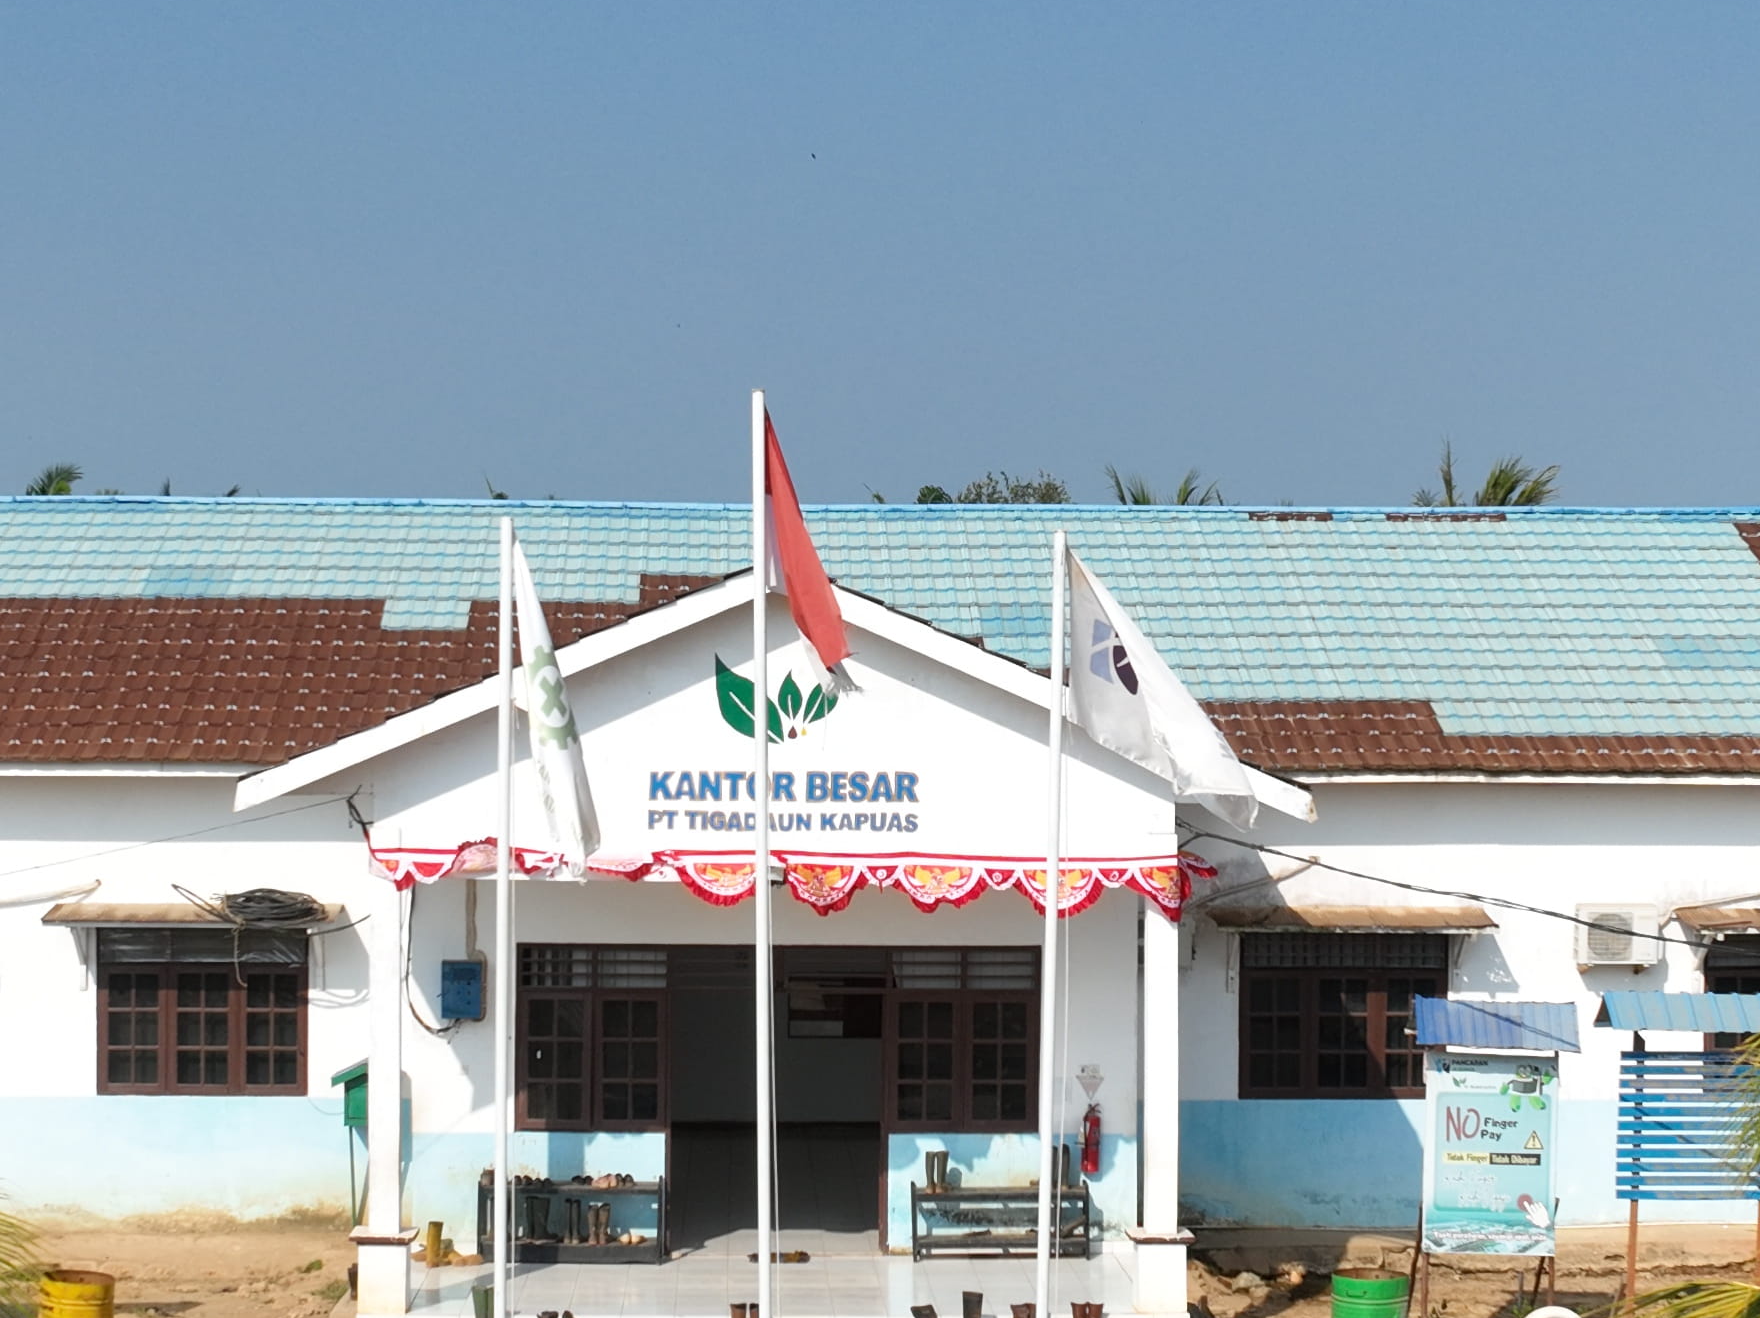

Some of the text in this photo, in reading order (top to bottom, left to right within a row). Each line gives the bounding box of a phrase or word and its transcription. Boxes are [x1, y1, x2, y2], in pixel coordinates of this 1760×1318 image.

[806, 771, 919, 803] BESAR
[648, 810, 678, 829] PT
[820, 813, 919, 832] KAPUAS
[1446, 1105, 1481, 1142] NO
[1484, 1117, 1519, 1129] Finger
[1480, 1129, 1502, 1141] Pay
